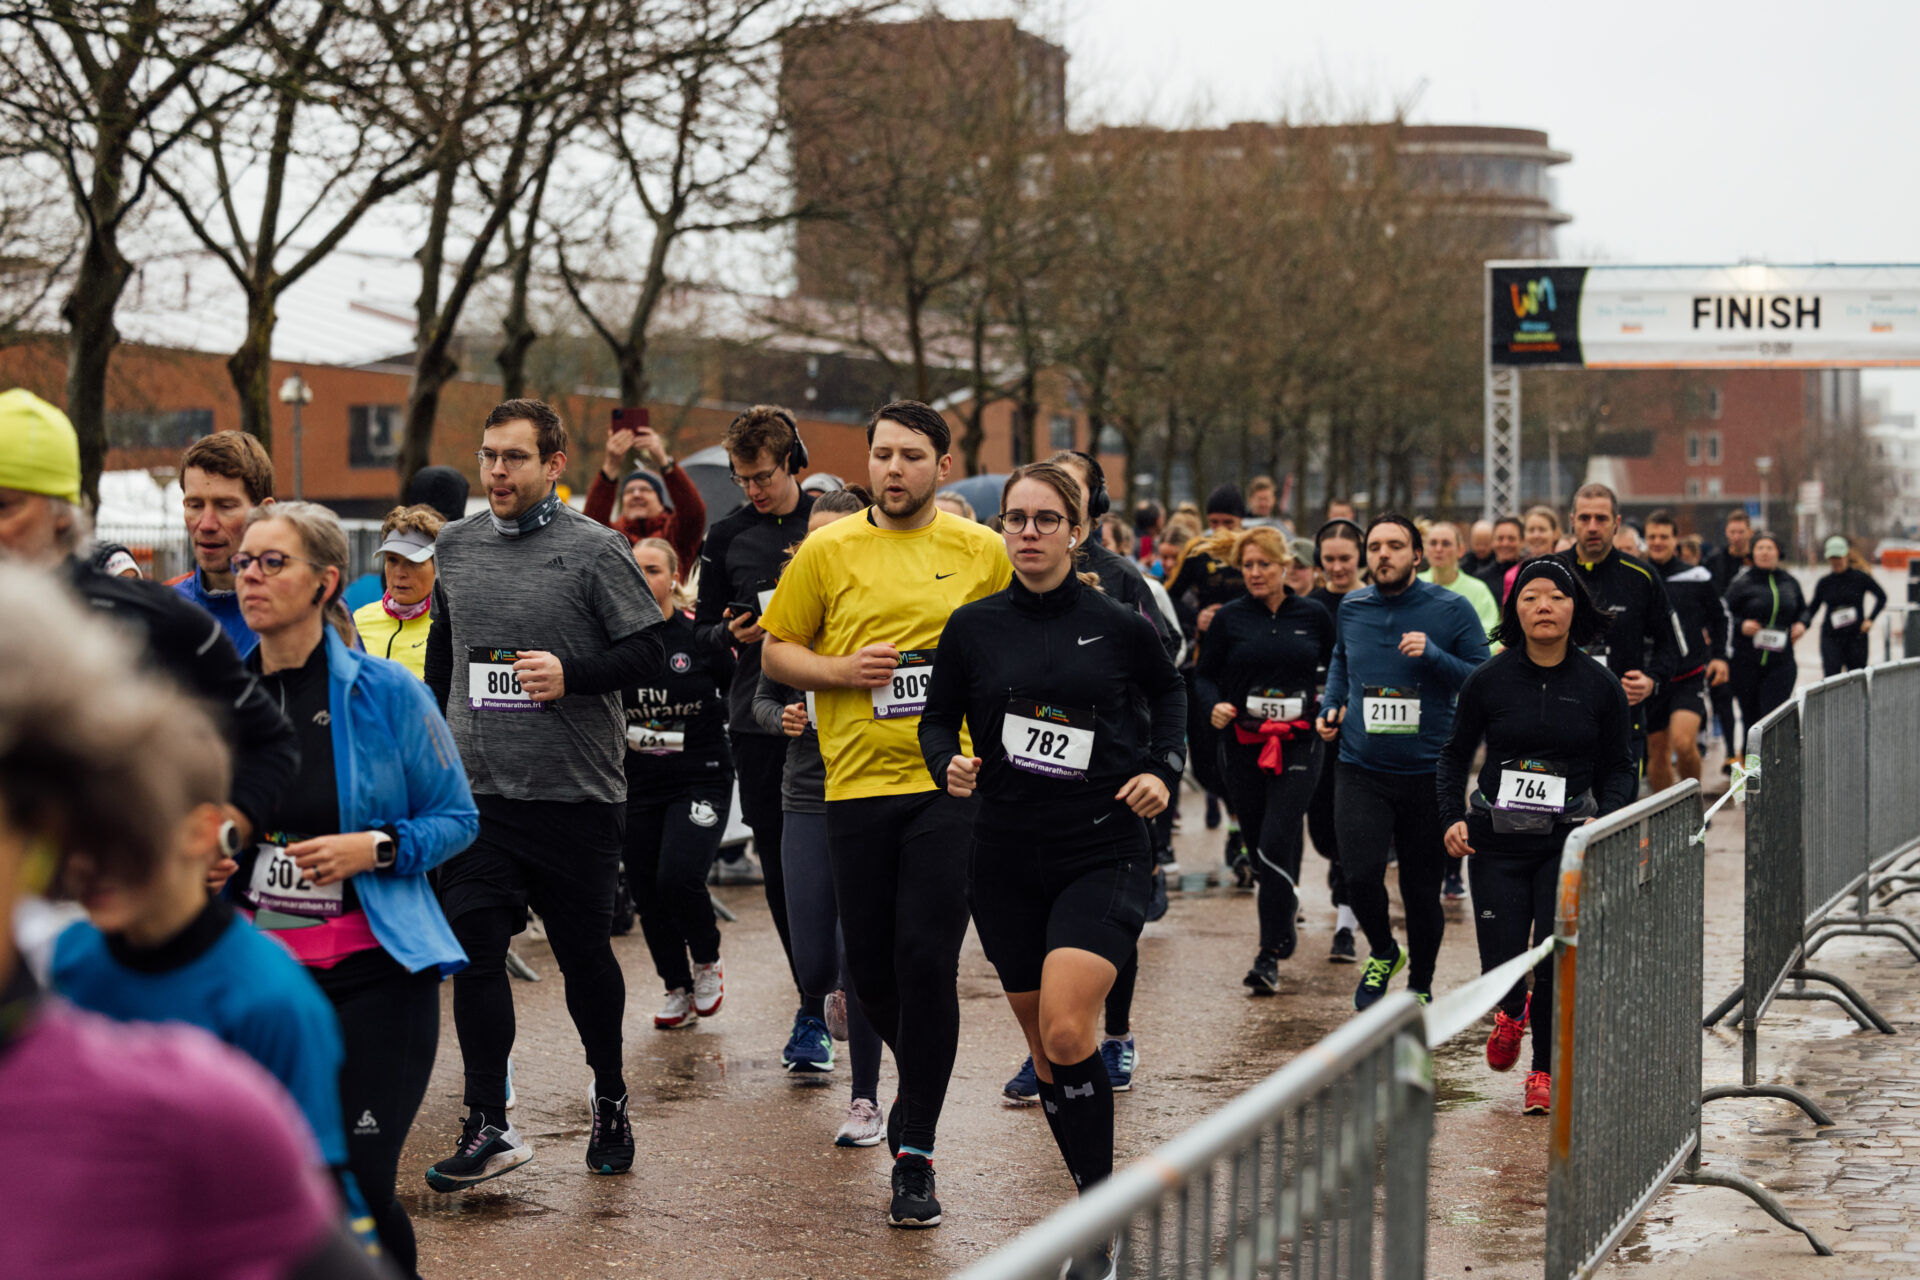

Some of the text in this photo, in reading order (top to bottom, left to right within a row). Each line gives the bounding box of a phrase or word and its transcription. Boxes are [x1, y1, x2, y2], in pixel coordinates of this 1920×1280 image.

[1692, 297, 1820, 328] FINISH
[487, 671, 522, 695] 808
[892, 674, 931, 699] 809
[483, 700, 541, 709] Wintermarathon.frl
[638, 687, 667, 705] Fly
[626, 699, 702, 720] mirates
[1261, 703, 1285, 719] 551
[1372, 703, 1406, 722] 2111
[1025, 727, 1069, 760] 782
[1515, 777, 1546, 800] 764
